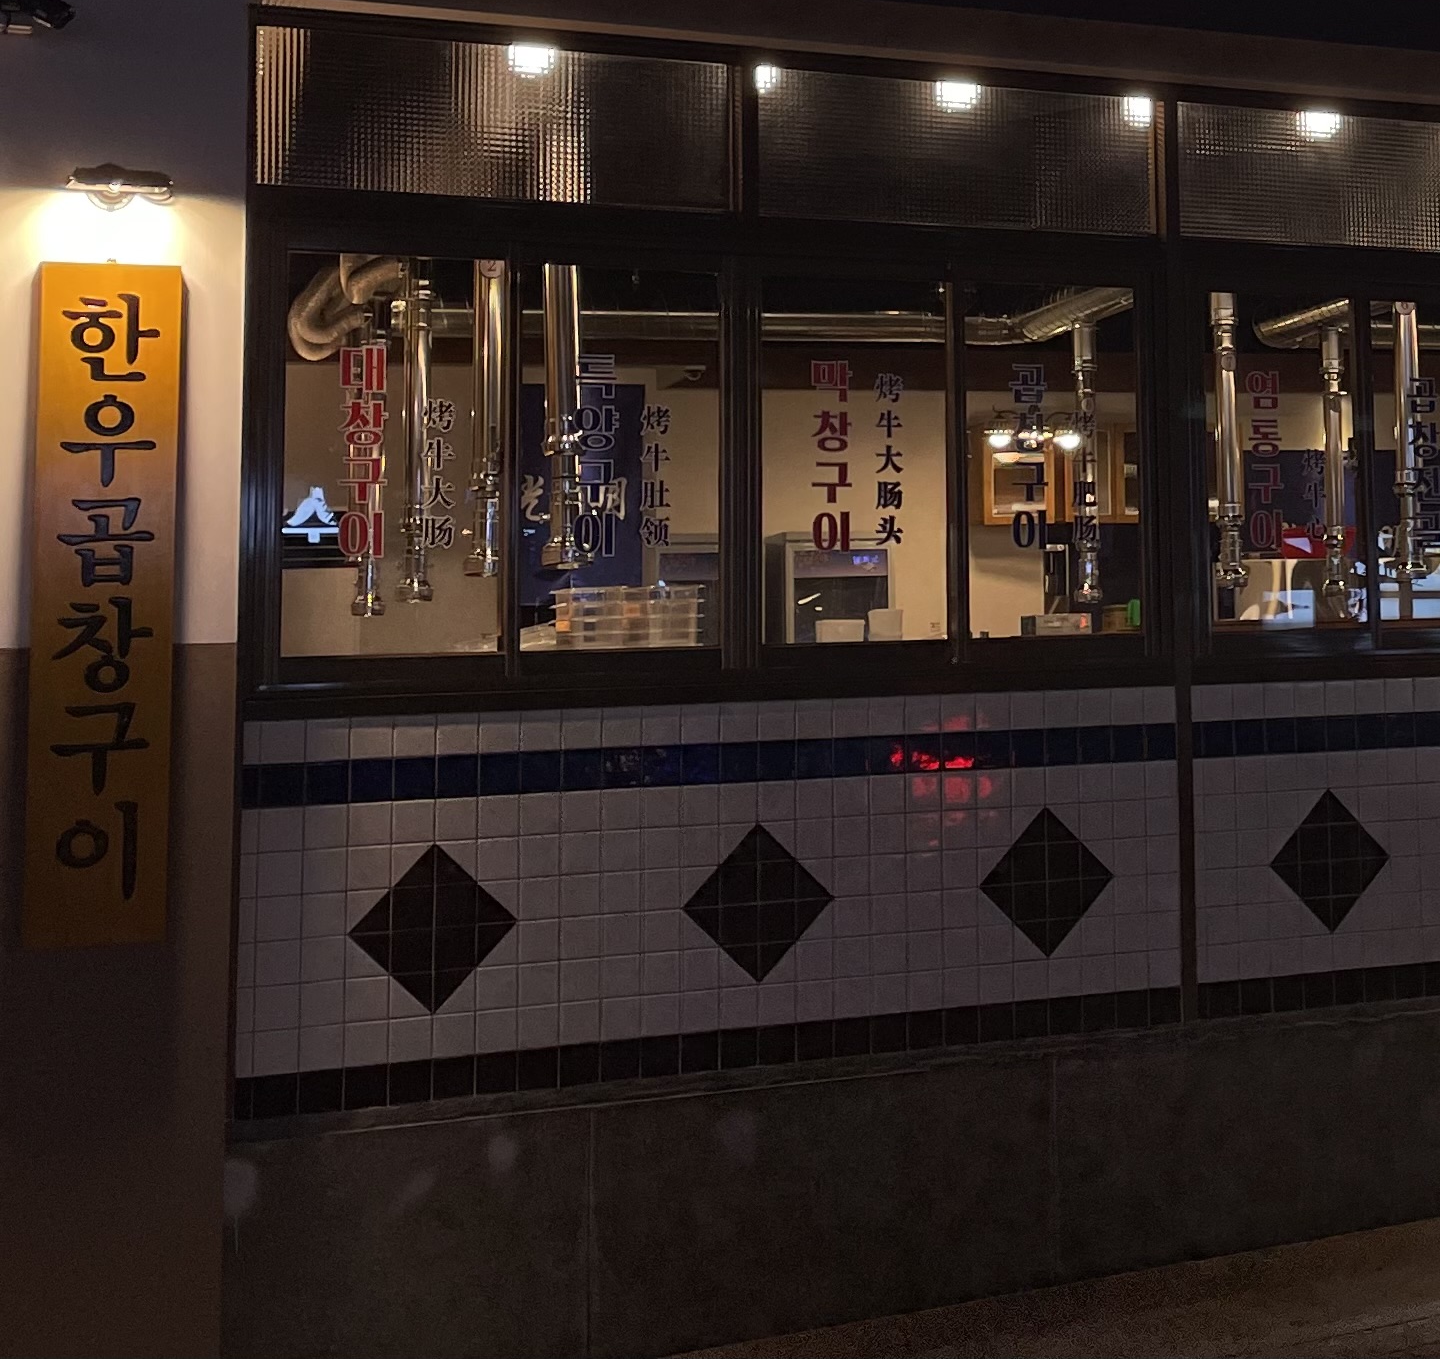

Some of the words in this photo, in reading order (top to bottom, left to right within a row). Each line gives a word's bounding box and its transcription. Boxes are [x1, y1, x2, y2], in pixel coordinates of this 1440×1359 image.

[338, 345, 389, 559] 대창구이
[811, 360, 853, 553] 막창구이
[50, 292, 160, 901] 한우곱창구이
